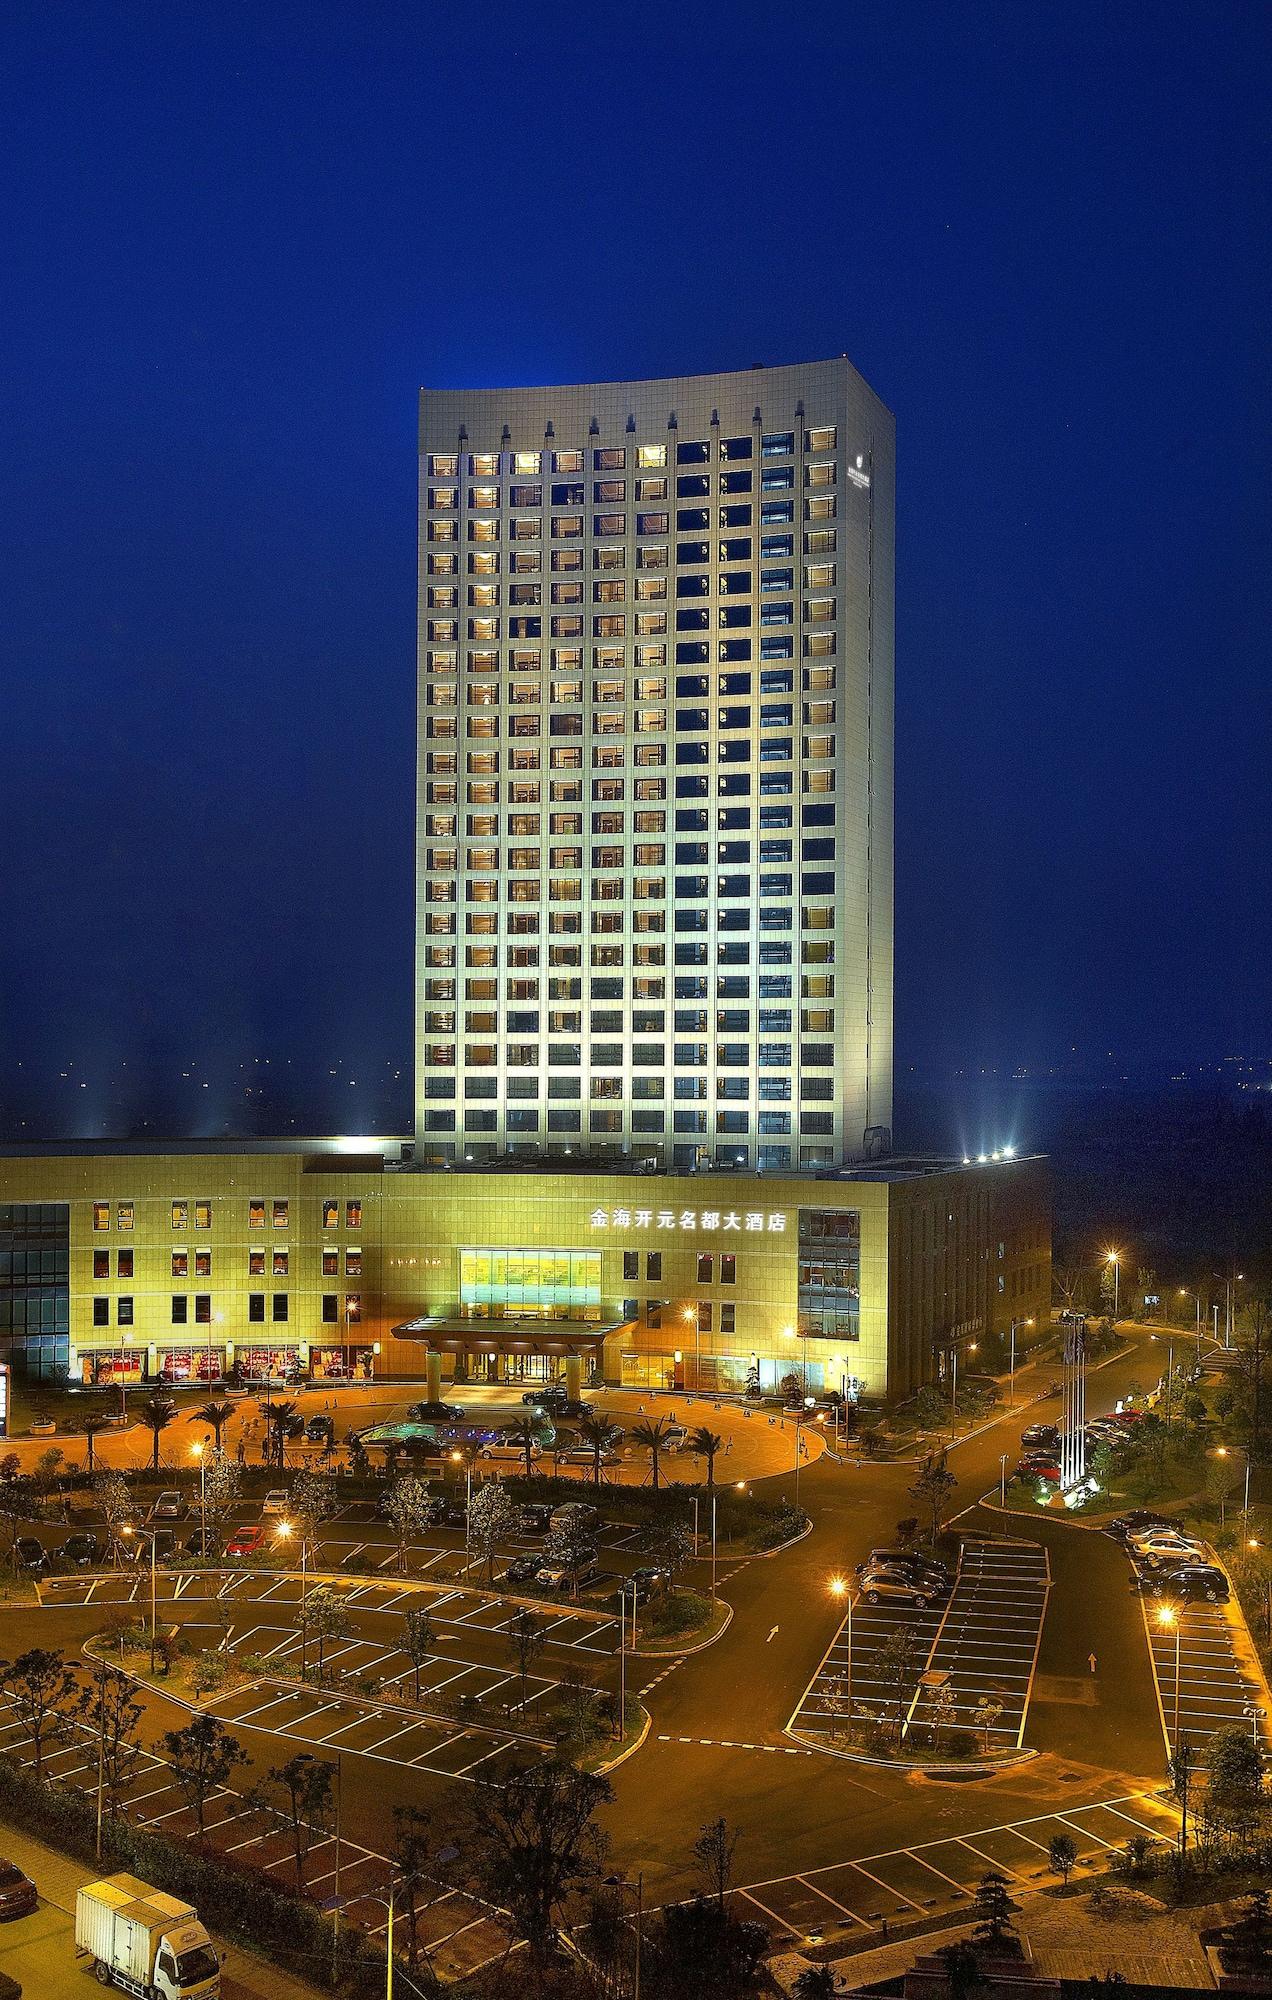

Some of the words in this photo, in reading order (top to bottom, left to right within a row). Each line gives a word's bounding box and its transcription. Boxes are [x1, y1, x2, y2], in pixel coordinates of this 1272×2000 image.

[590, 1208, 787, 1232] 金海开元名都大酒店
